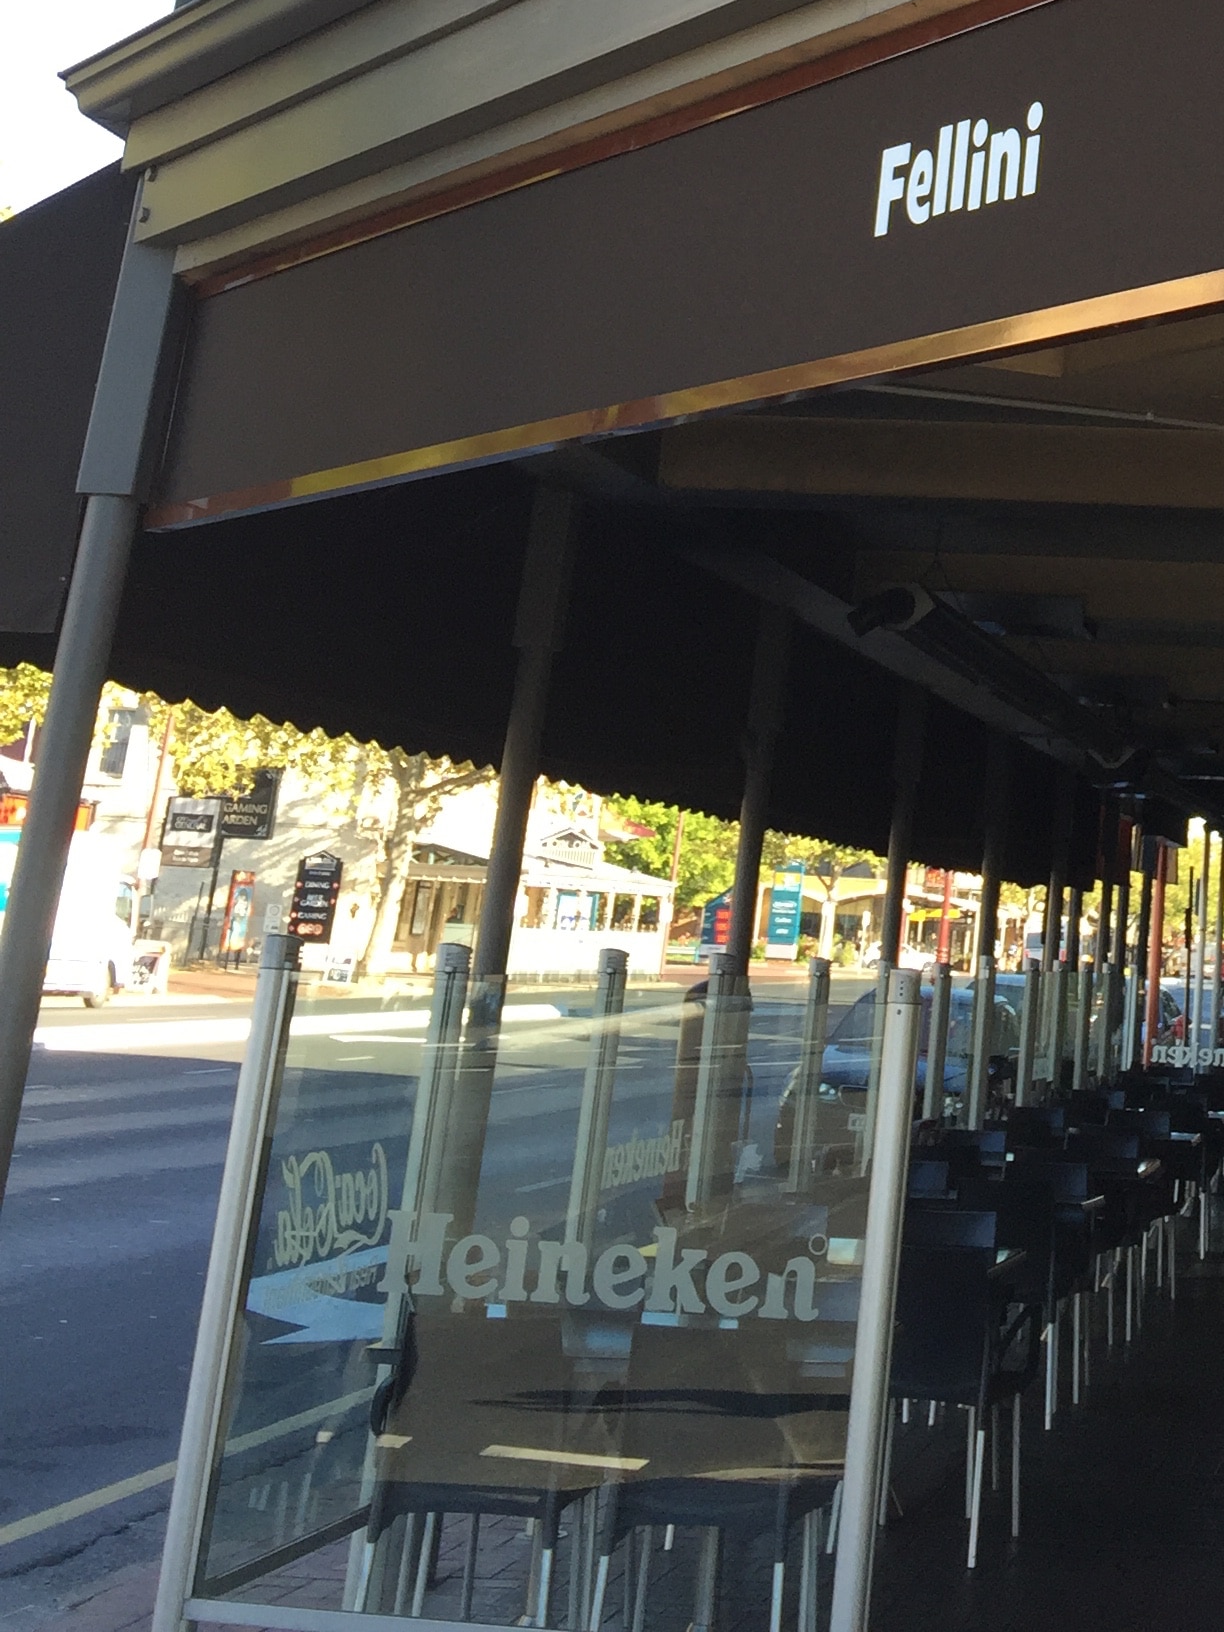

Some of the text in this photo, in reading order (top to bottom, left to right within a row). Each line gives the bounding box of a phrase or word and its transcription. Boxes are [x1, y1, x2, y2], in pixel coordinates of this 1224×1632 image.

[874, 101, 1044, 238] Fellini
[223, 802, 268, 815] GAMING
[221, 814, 258, 826] ARDEN
[305, 880, 331, 889] DINING
[376, 1209, 820, 1322] Heineken
